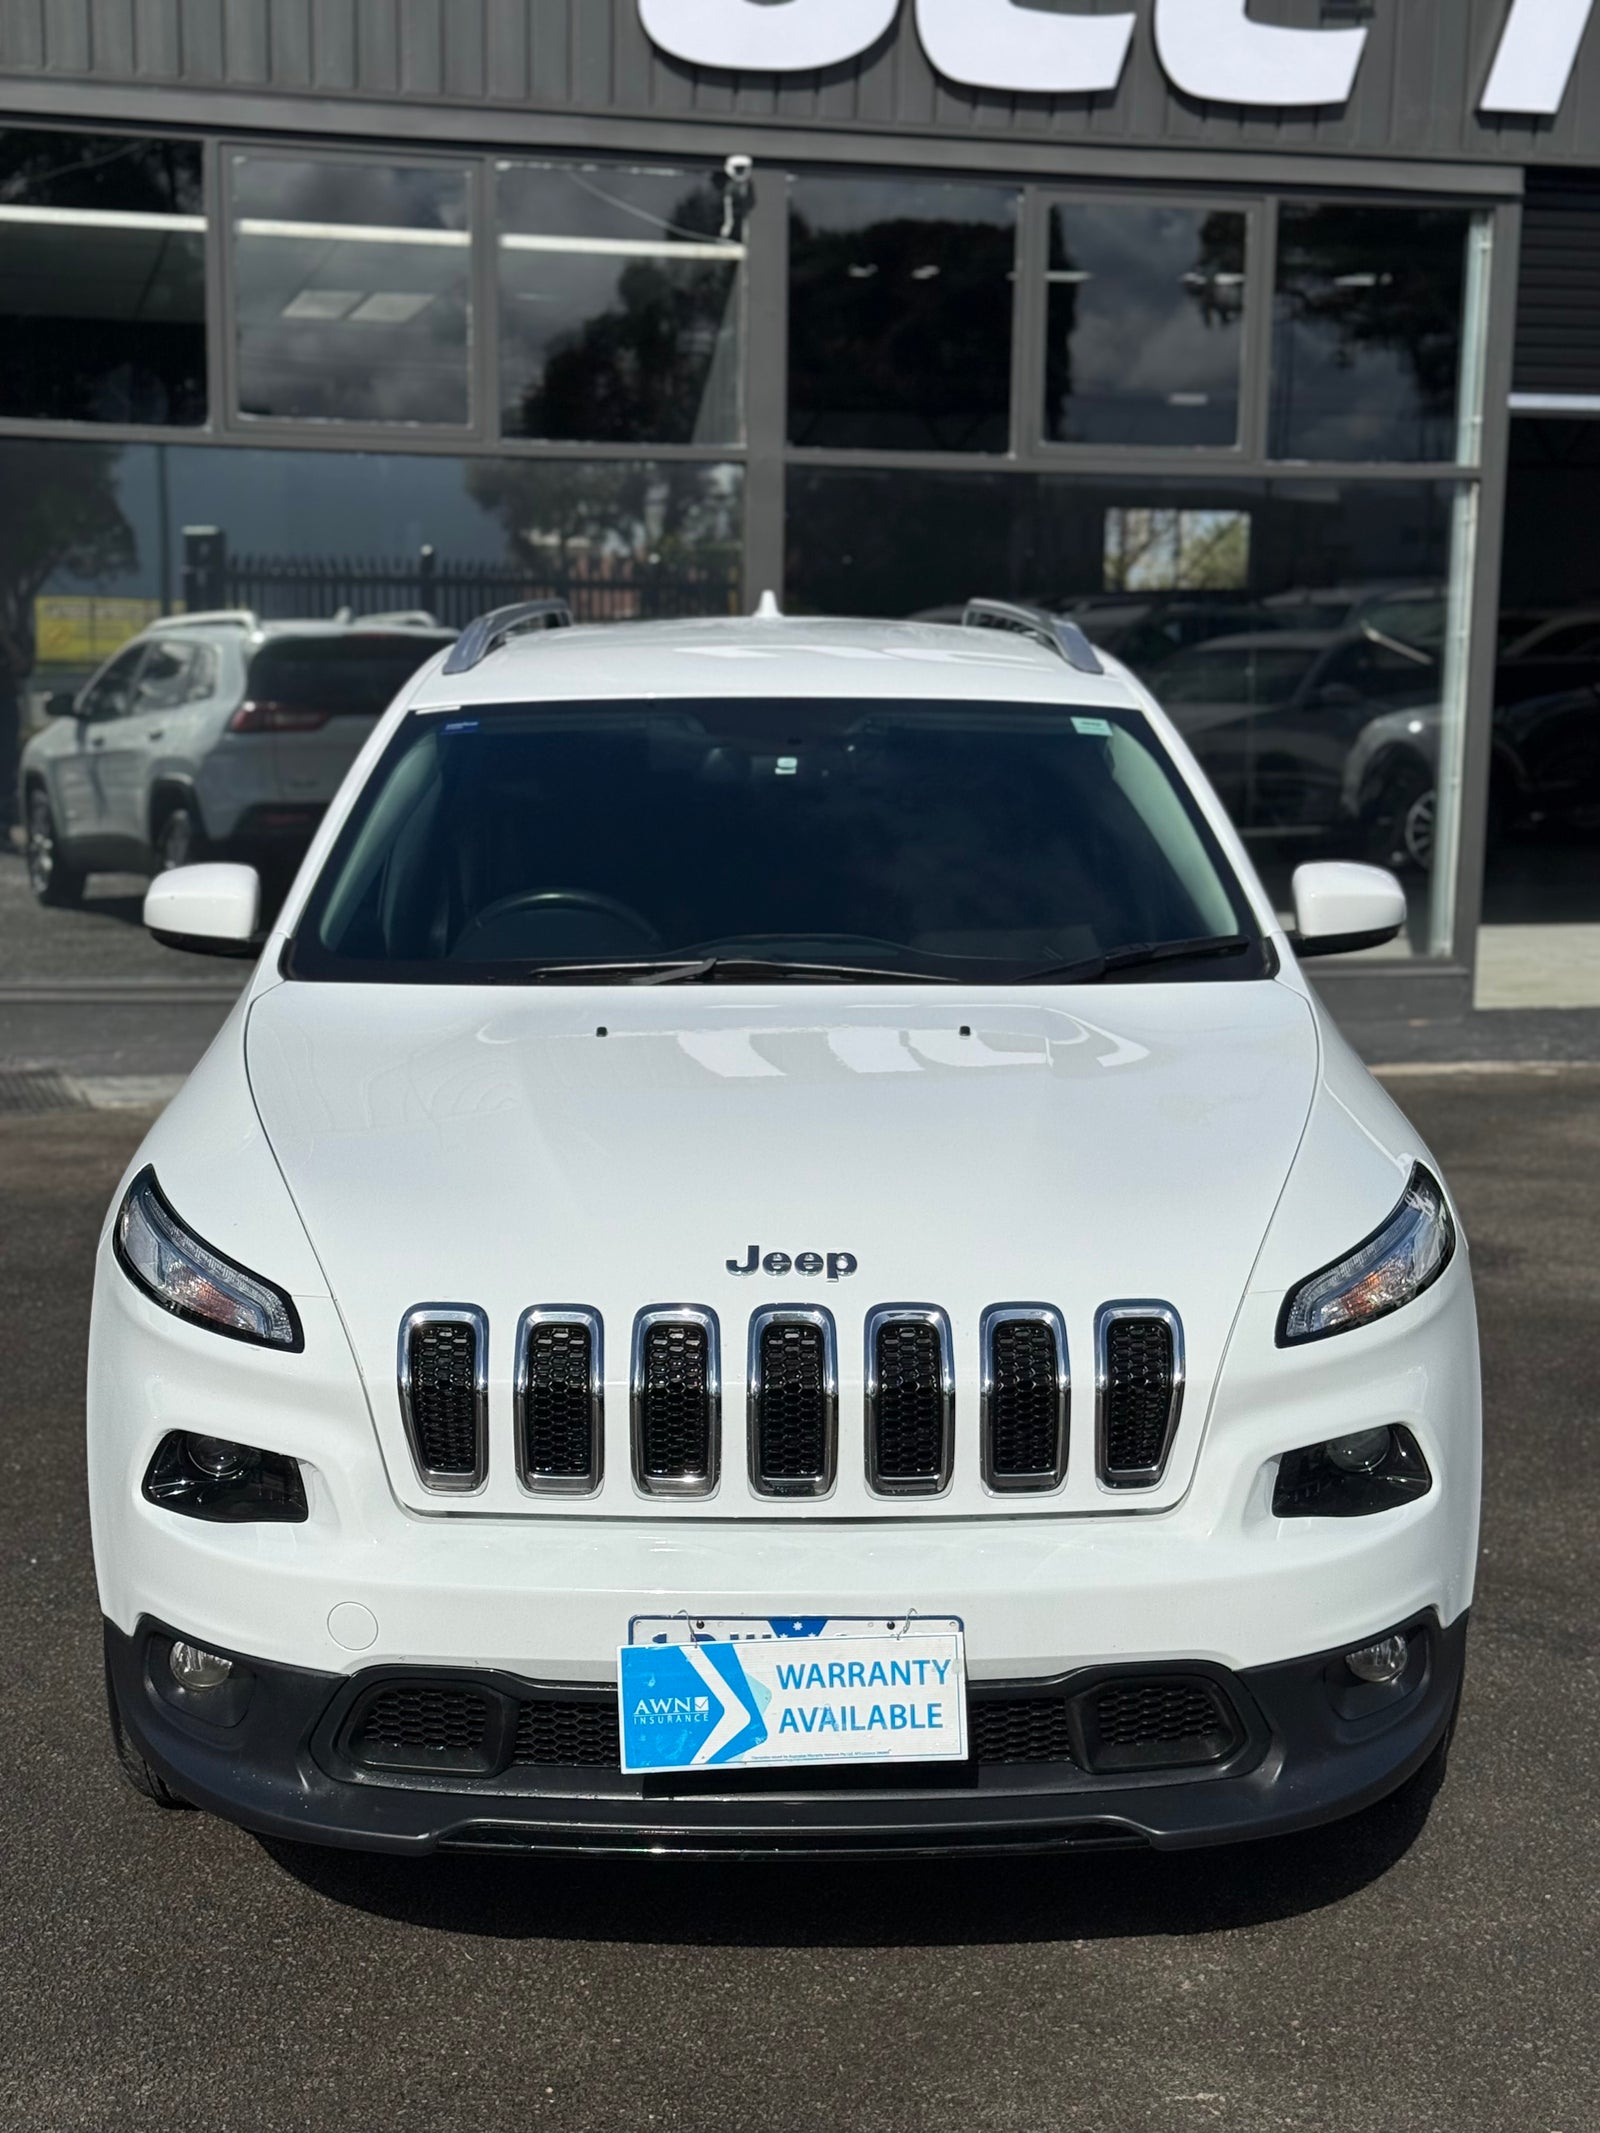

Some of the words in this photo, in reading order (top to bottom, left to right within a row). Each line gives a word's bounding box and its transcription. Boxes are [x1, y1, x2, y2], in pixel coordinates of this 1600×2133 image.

[726, 1245, 857, 1282] Jeep
[776, 1659, 951, 1690] WARRANTY
[633, 1697, 691, 1714] AWN
[633, 1713, 709, 1725] INSURANCE
[779, 1703, 943, 1733] AVAILABLE
